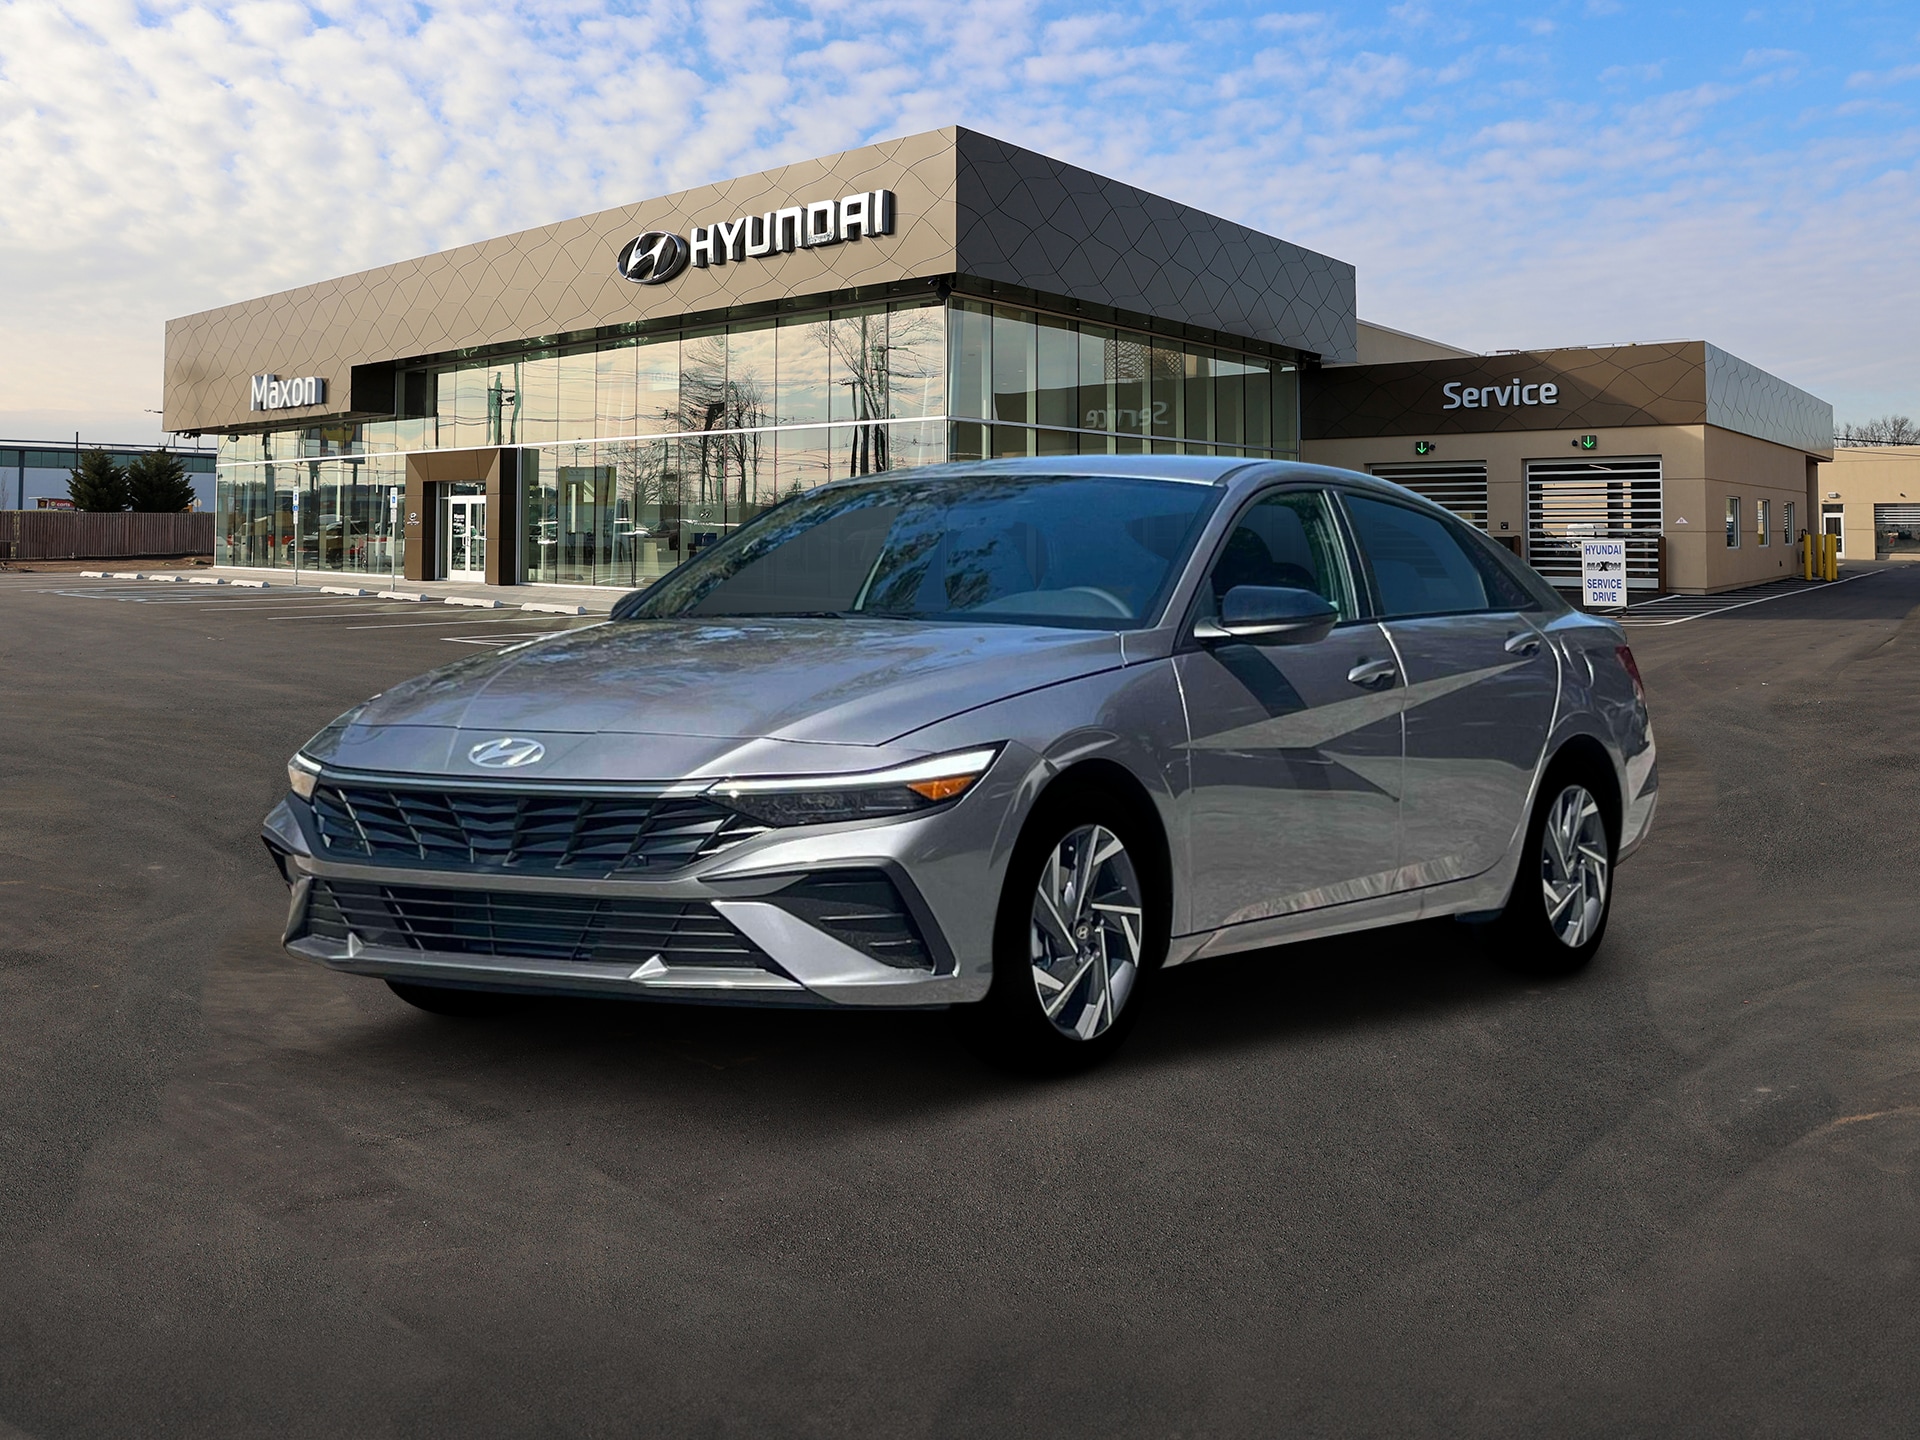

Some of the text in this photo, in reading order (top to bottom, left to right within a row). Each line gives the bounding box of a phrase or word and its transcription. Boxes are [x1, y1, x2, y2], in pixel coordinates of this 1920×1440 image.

[690, 189, 893, 267] HYUNDAI
[250, 374, 324, 411] Maxon
[1443, 378, 1558, 409] Service
[1585, 545, 1622, 555] HYUNDAI
[1586, 561, 1622, 572] MAXON
[1586, 579, 1622, 589] SERVICE
[1592, 592, 1617, 602] DRIVE
